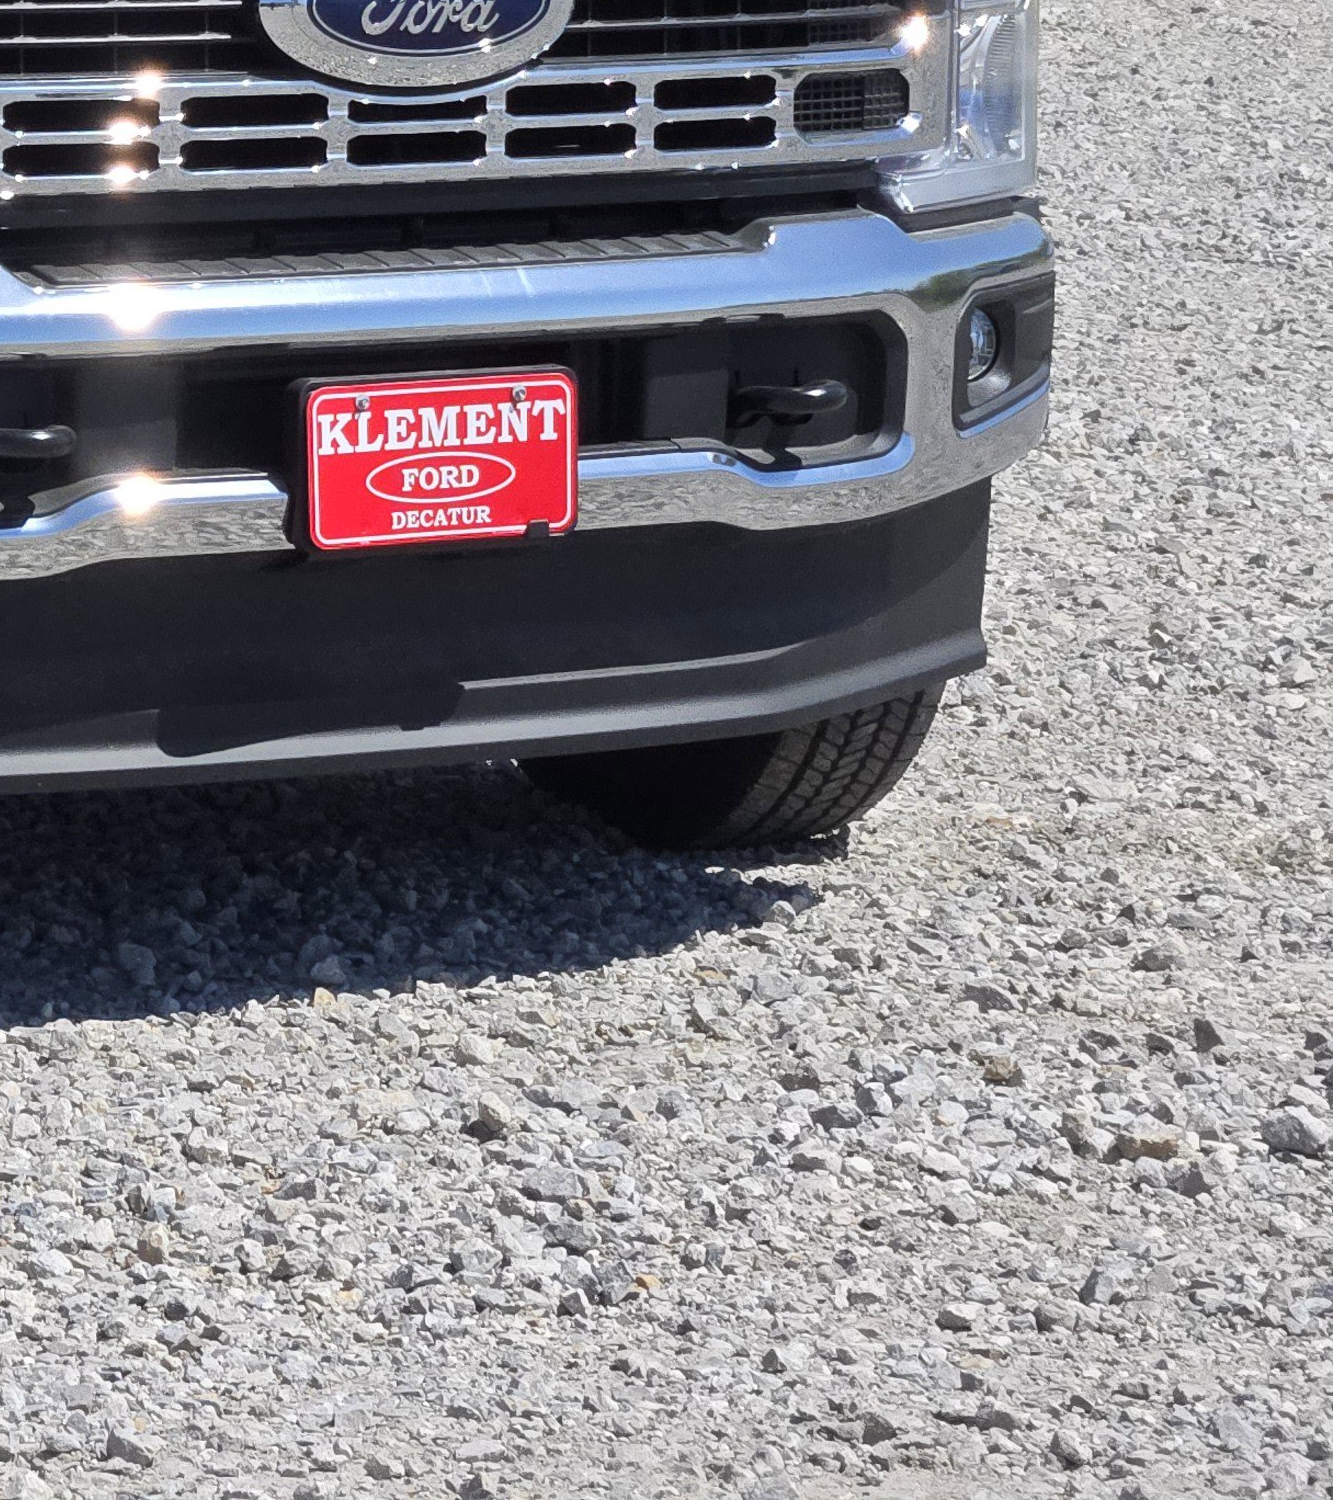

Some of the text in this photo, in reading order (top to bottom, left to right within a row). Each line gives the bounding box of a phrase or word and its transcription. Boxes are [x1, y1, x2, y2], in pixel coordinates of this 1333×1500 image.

[317, 398, 566, 456] KLEMENT
[401, 463, 481, 493] FORD
[391, 504, 492, 531] DECATUR
